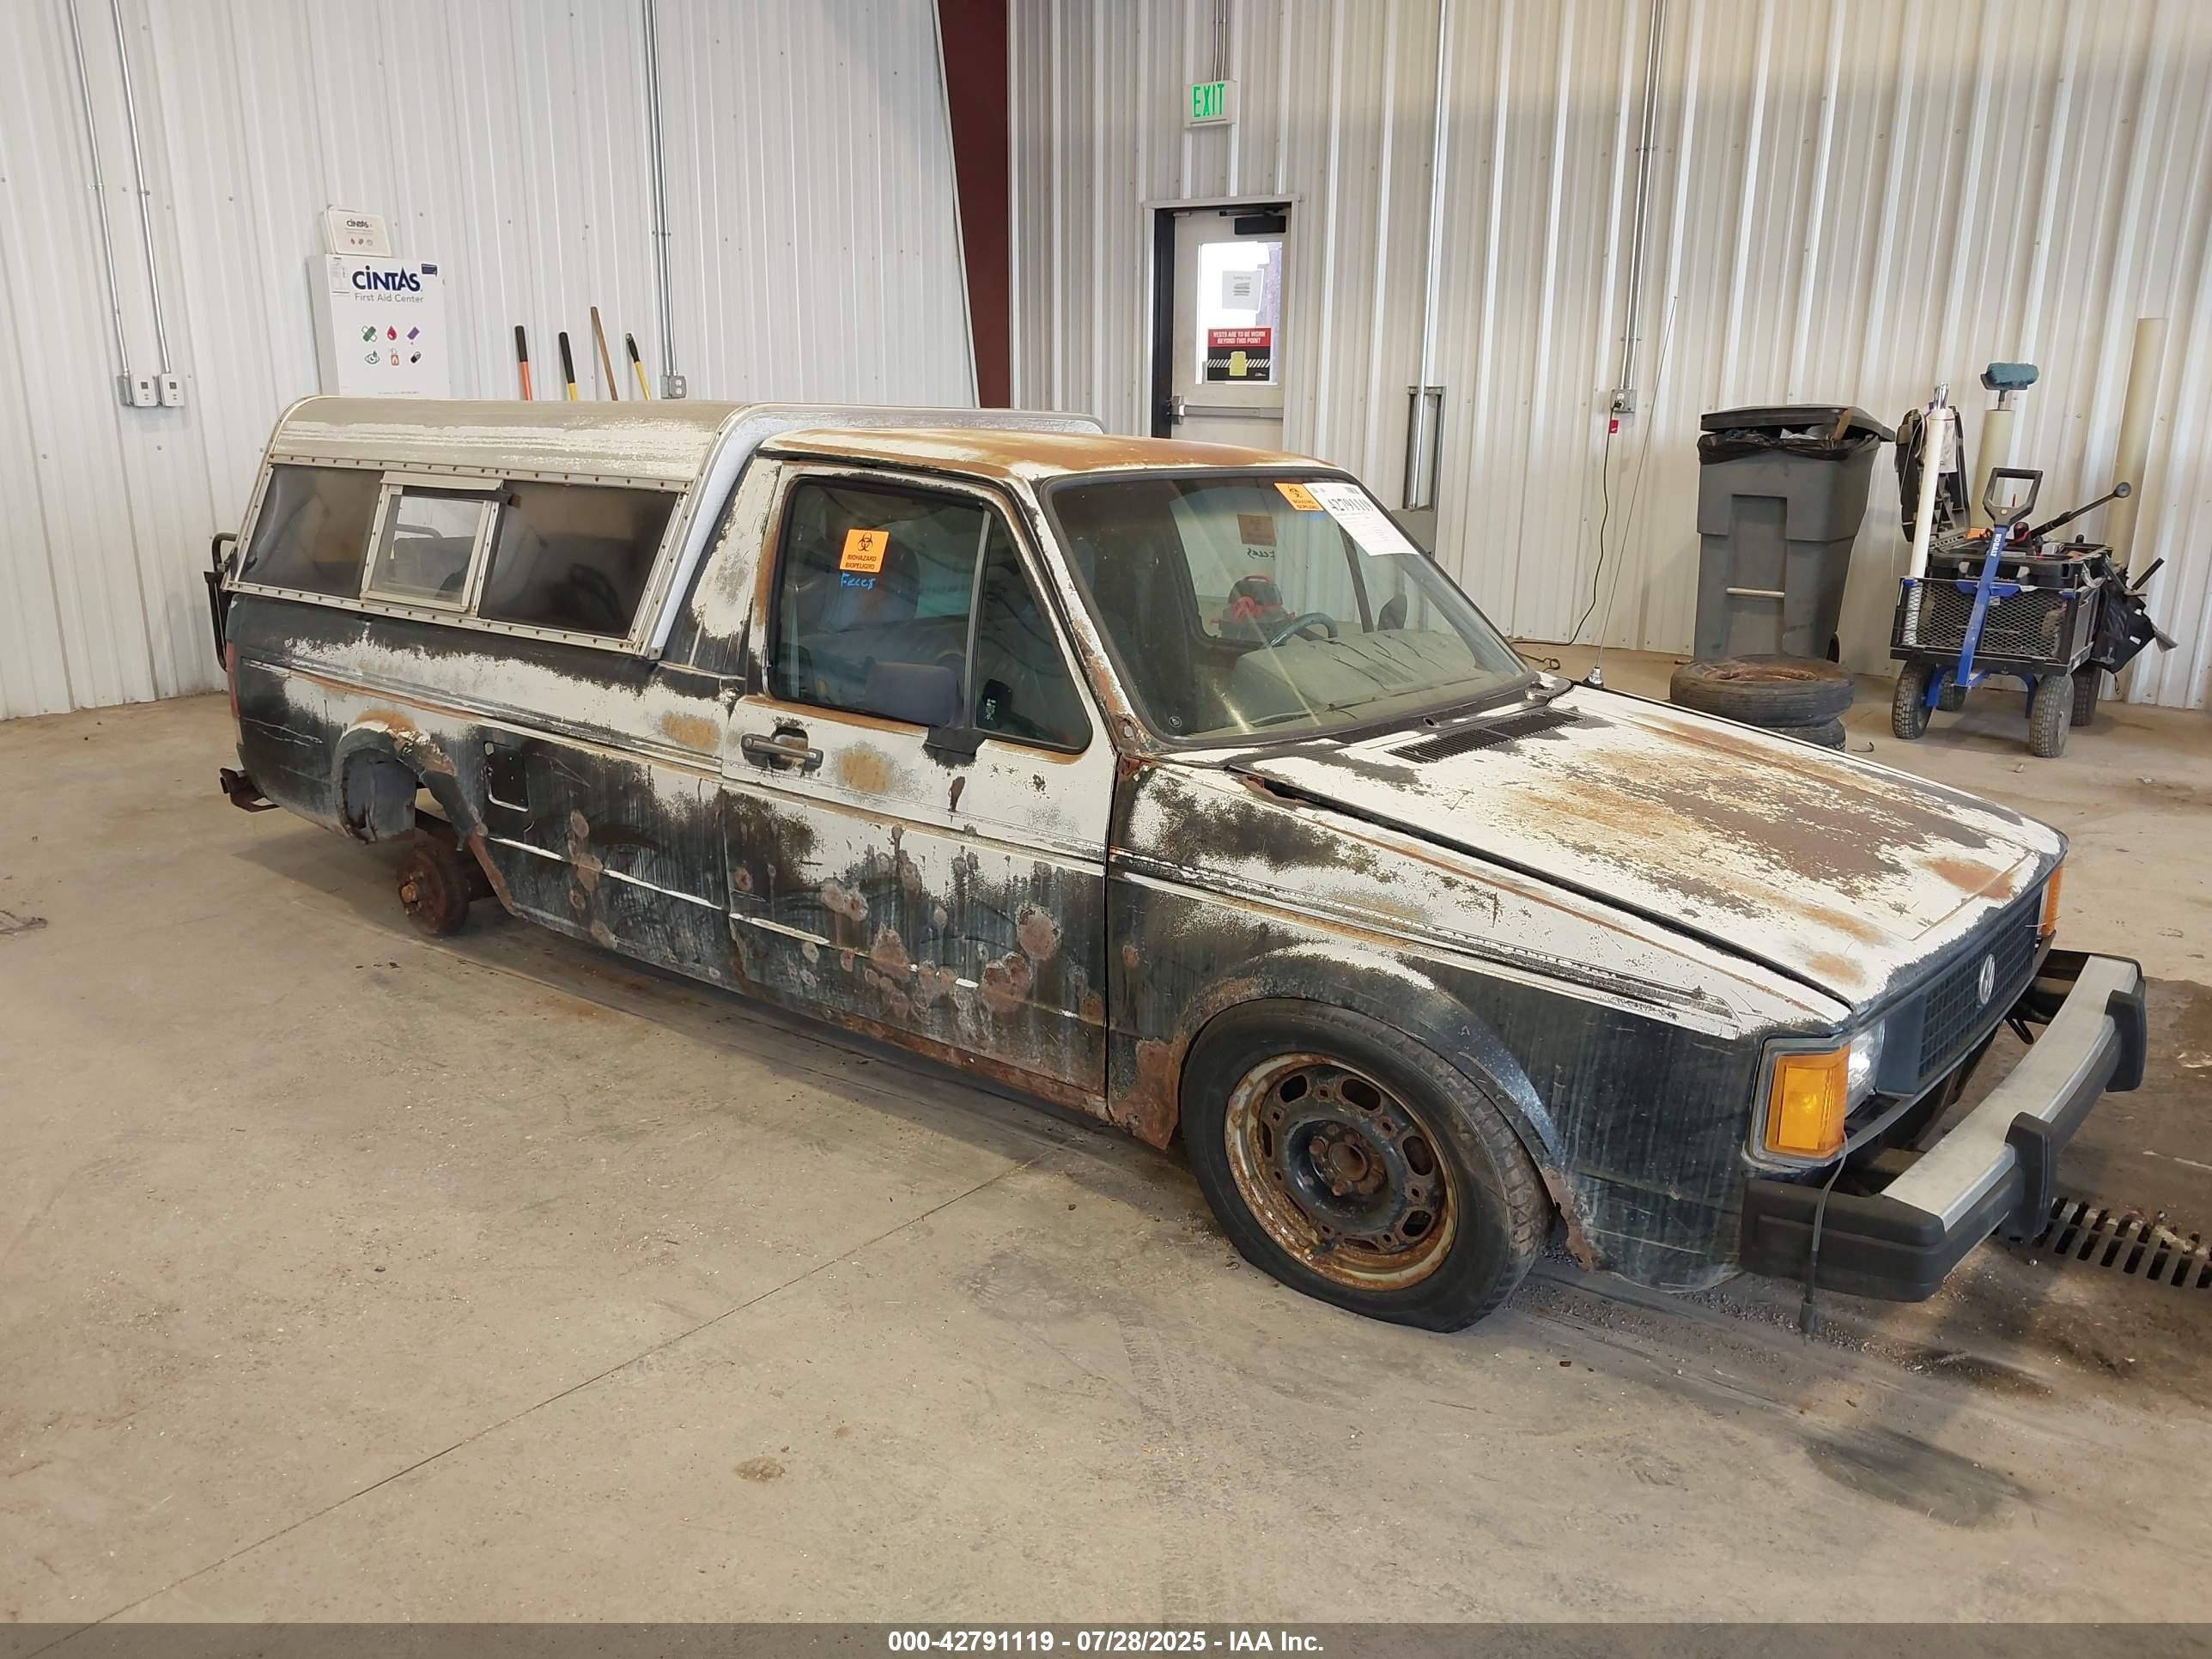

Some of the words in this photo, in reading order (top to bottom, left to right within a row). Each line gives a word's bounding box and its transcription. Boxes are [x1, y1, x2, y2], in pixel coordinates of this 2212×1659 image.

[1194, 83, 1224, 117] EXIT
[355, 293, 374, 301] First
[377, 294, 392, 302] Aid
[395, 294, 424, 303] Center
[1990, 533, 2002, 557] KOBALT
[847, 554, 877, 562] BIOHAZARD
